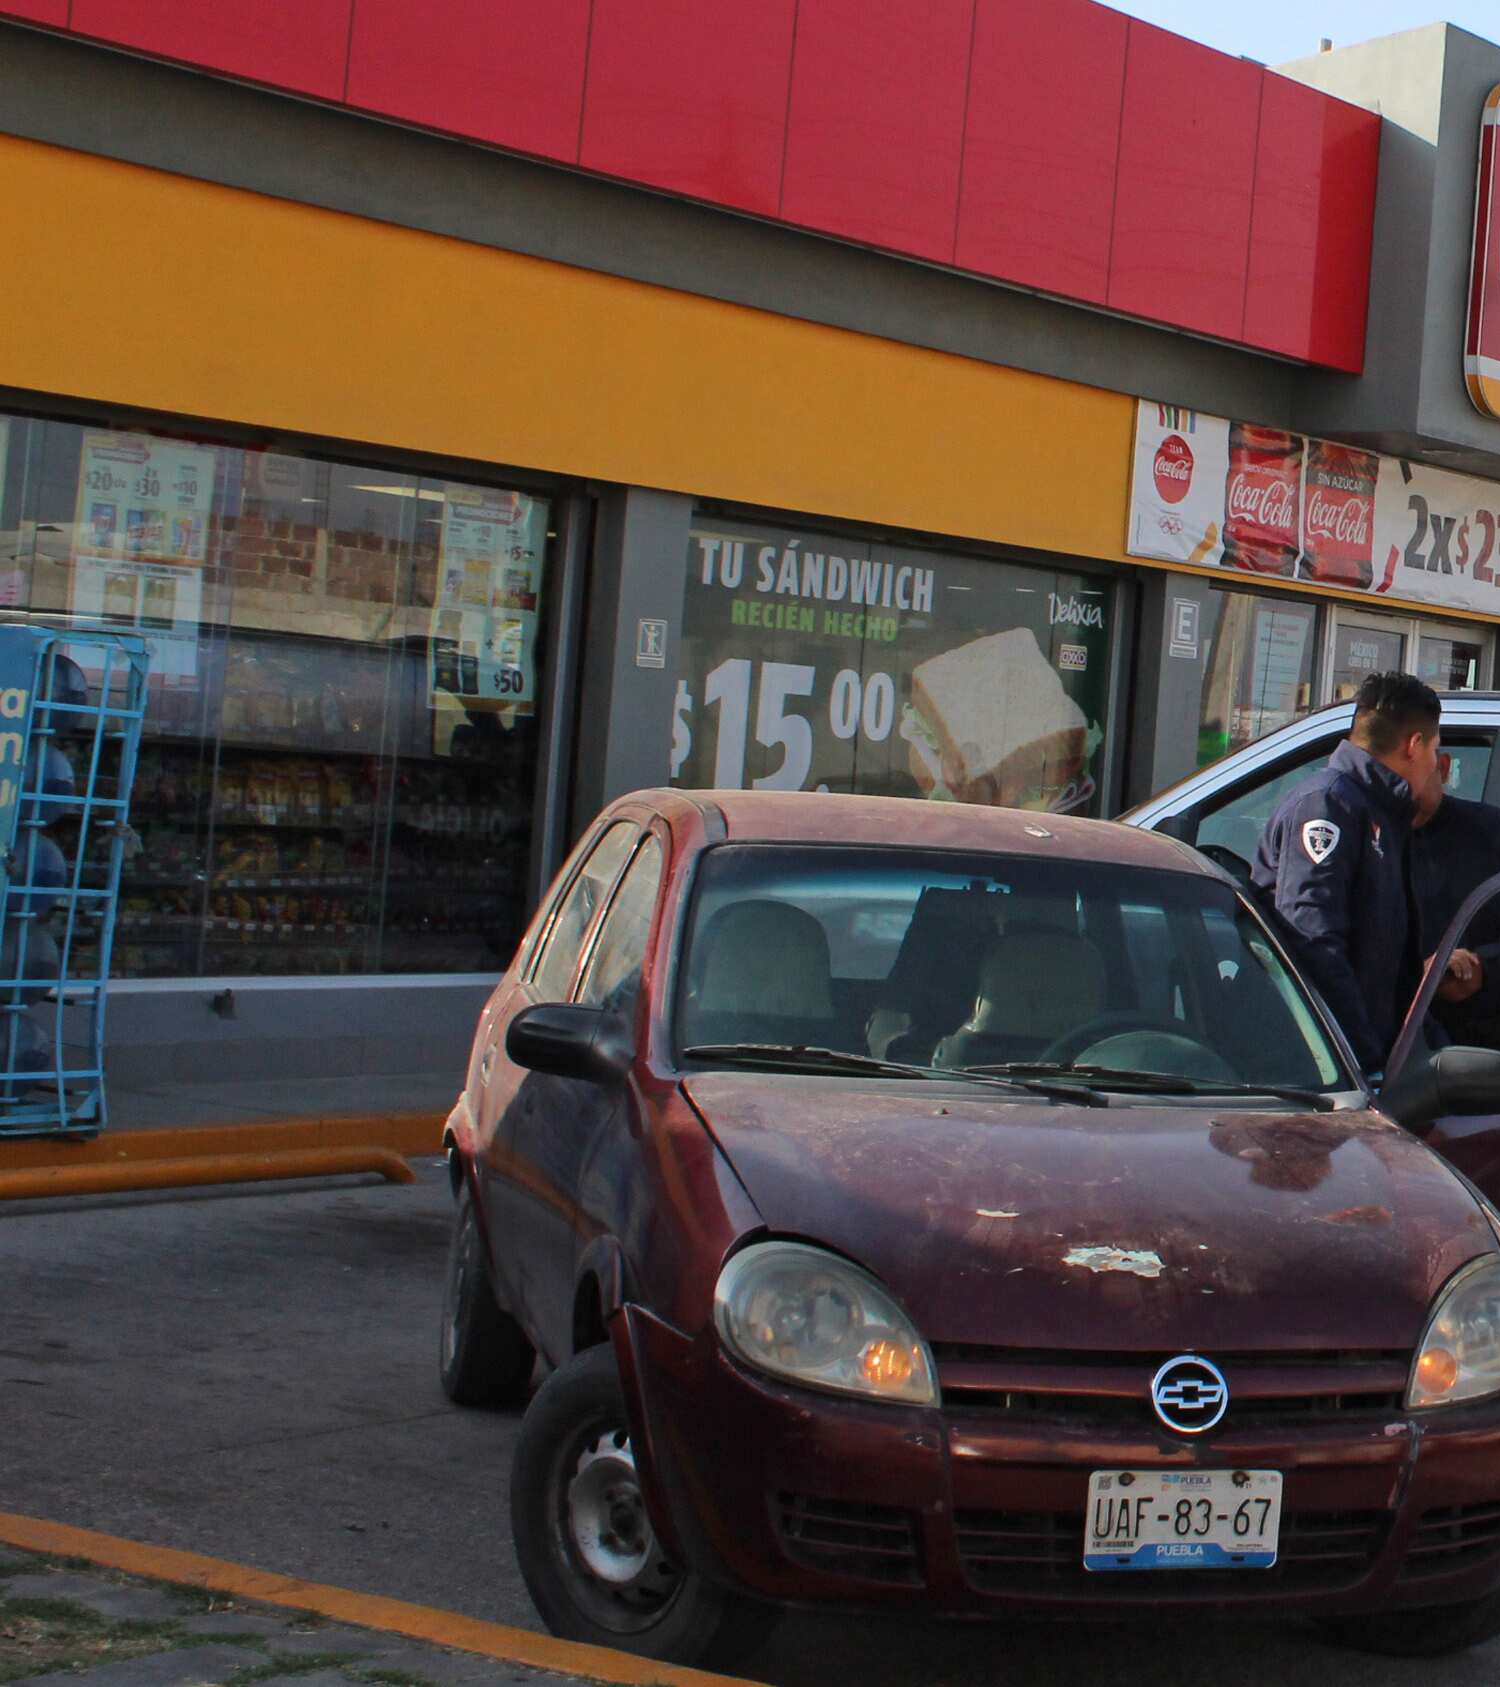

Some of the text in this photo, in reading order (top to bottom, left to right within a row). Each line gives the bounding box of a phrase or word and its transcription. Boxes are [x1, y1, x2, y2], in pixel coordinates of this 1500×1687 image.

[1229, 473, 1296, 528] Coca-Cola
[1307, 491, 1369, 544] Coca-Cola
[699, 539, 934, 612] TU SÁNDWICH
[731, 600, 898, 642] RECIÉN HECHO
[1178, 606, 1194, 641] E
[1062, 650, 1087, 665] OXXO
[1093, 1497, 1272, 1540] UAF-83-67
[1156, 1543, 1204, 1556] PUEBLA
